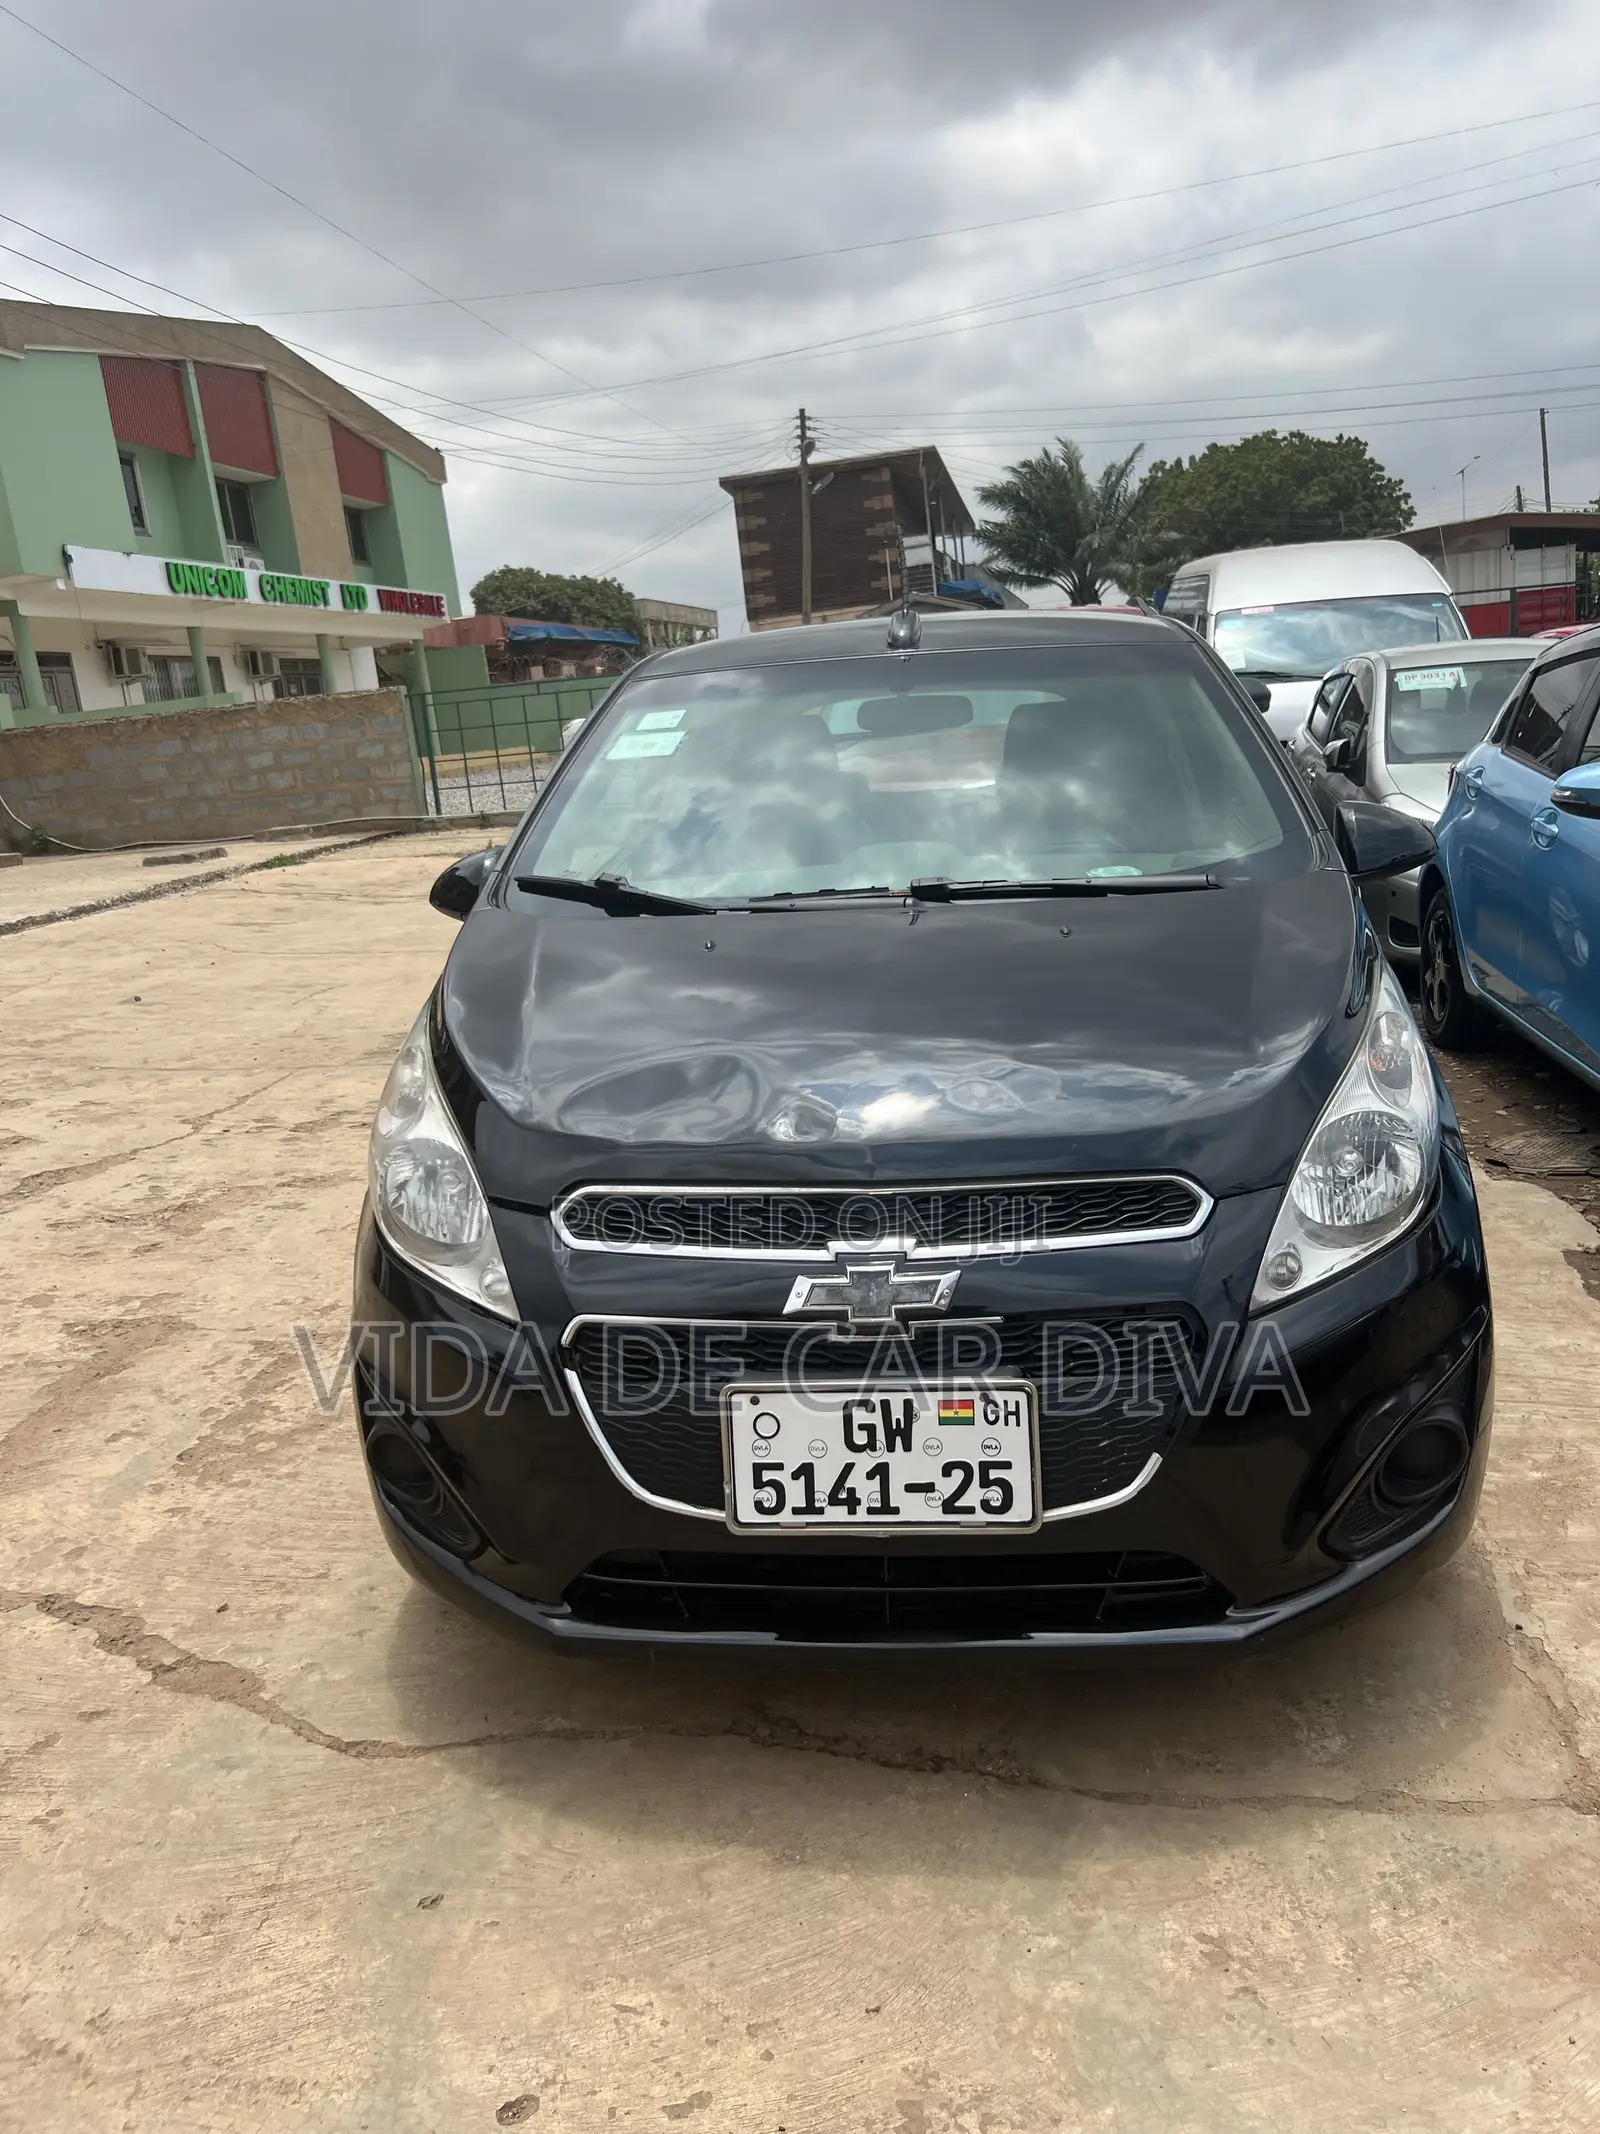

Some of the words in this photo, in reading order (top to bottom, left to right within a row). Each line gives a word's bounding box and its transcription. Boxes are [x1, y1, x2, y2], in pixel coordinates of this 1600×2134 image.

[166, 562, 248, 600] UNICOM
[259, 573, 330, 608] CHEMIST
[339, 584, 369, 611] LTD
[377, 588, 446, 617] WHOLESALE
[842, 1398, 914, 1453] GW
[983, 1399, 1021, 1427] GH
[925, 1442, 941, 1450] DVLA
[983, 1442, 999, 1450] DVLA
[752, 1460, 1014, 1516] 5141-25
